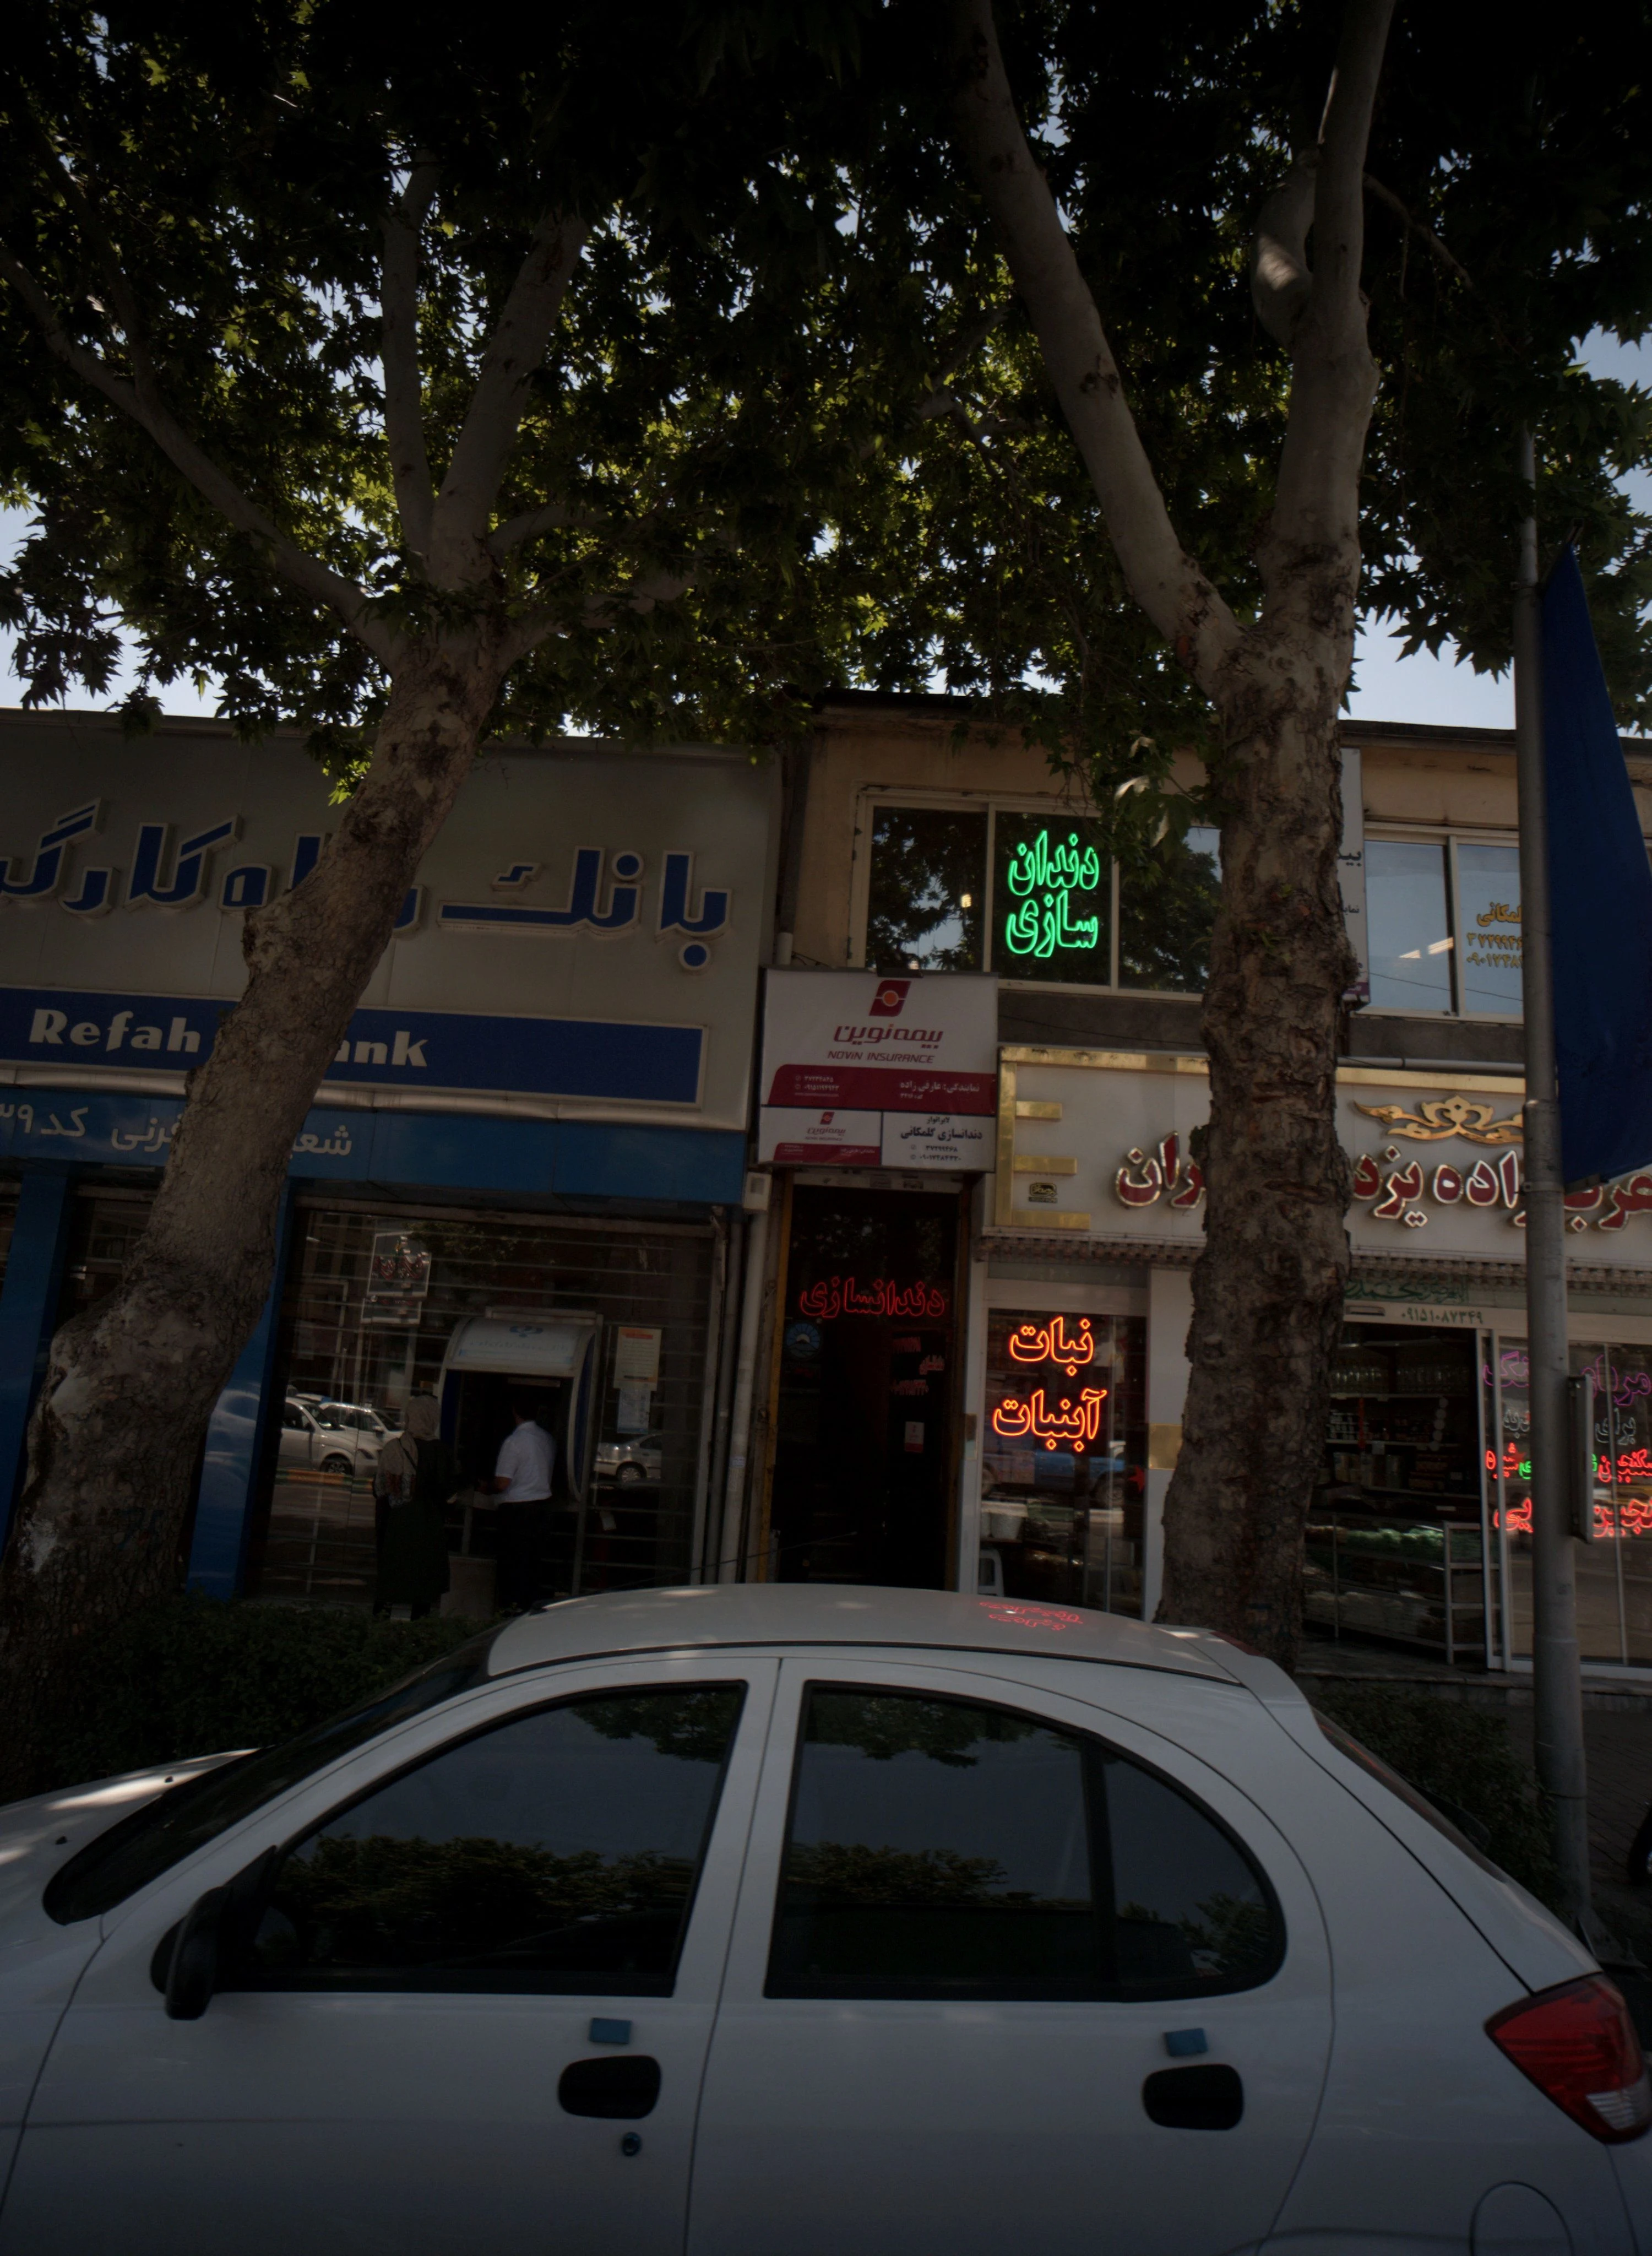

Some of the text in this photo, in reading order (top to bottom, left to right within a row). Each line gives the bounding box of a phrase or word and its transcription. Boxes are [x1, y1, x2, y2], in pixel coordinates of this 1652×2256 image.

[1008, 828, 1100, 896] دندان
[1005, 888, 1099, 958] سازی
[28, 1008, 202, 1053] Refah
[867, 1052, 936, 1064] INSURANCE
[40, 1107, 90, 1138] کد
[938, 1128, 983, 1141] دندانسازی
[798, 1275, 947, 1319] دندانسازی
[1402, 1306, 1483, 1325] ۰۹۱۵۱۰۸۷۳۴۹
[1009, 1315, 1095, 1377] نبات
[992, 1387, 1108, 1453] آبنبات
